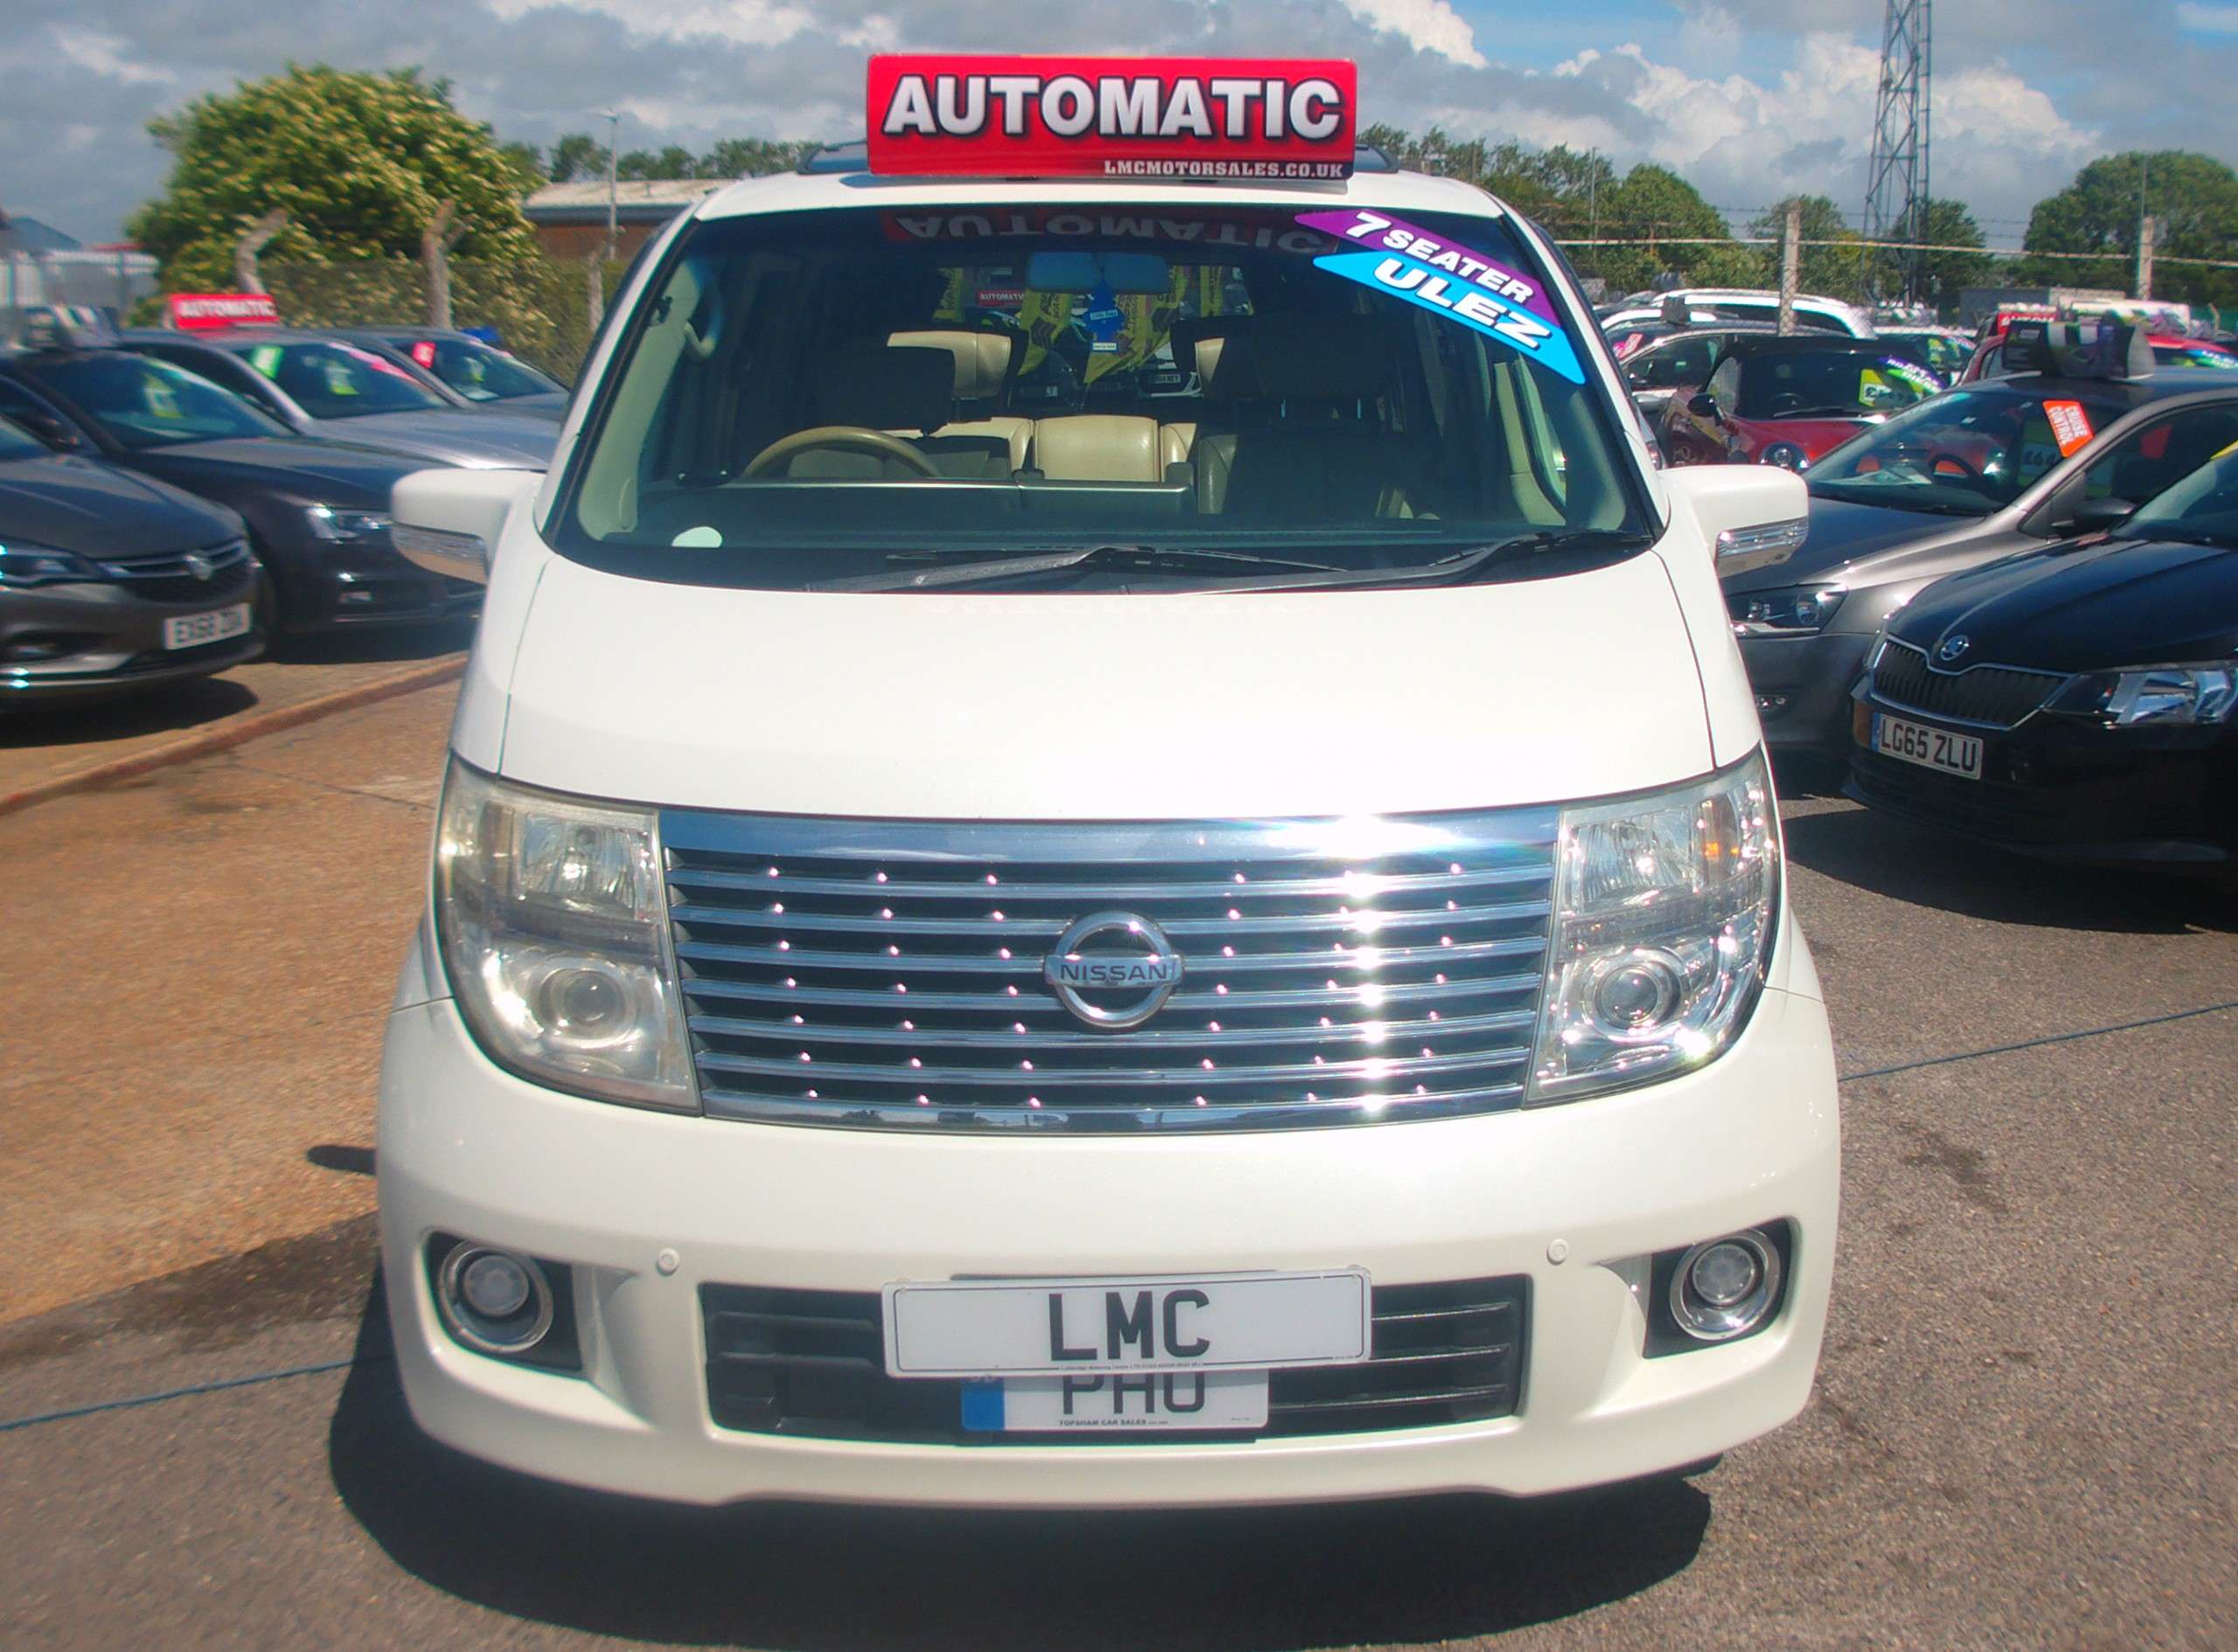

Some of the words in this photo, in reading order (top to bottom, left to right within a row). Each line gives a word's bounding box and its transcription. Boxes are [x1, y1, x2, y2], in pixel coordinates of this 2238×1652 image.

[883, 73, 1341, 141] AUTOMATIC
[1104, 160, 1344, 178] LMCMOTORSALES.CO.UK
[1346, 212, 1392, 239] 7
[1381, 229, 1534, 305] SEATER
[1374, 258, 1553, 349] ULEZ
[1880, 718, 1929, 759] LG65
[1933, 734, 1977, 772] ZLU
[1060, 963, 1168, 982] NISSAN
[1048, 1288, 1211, 1362] LMC
